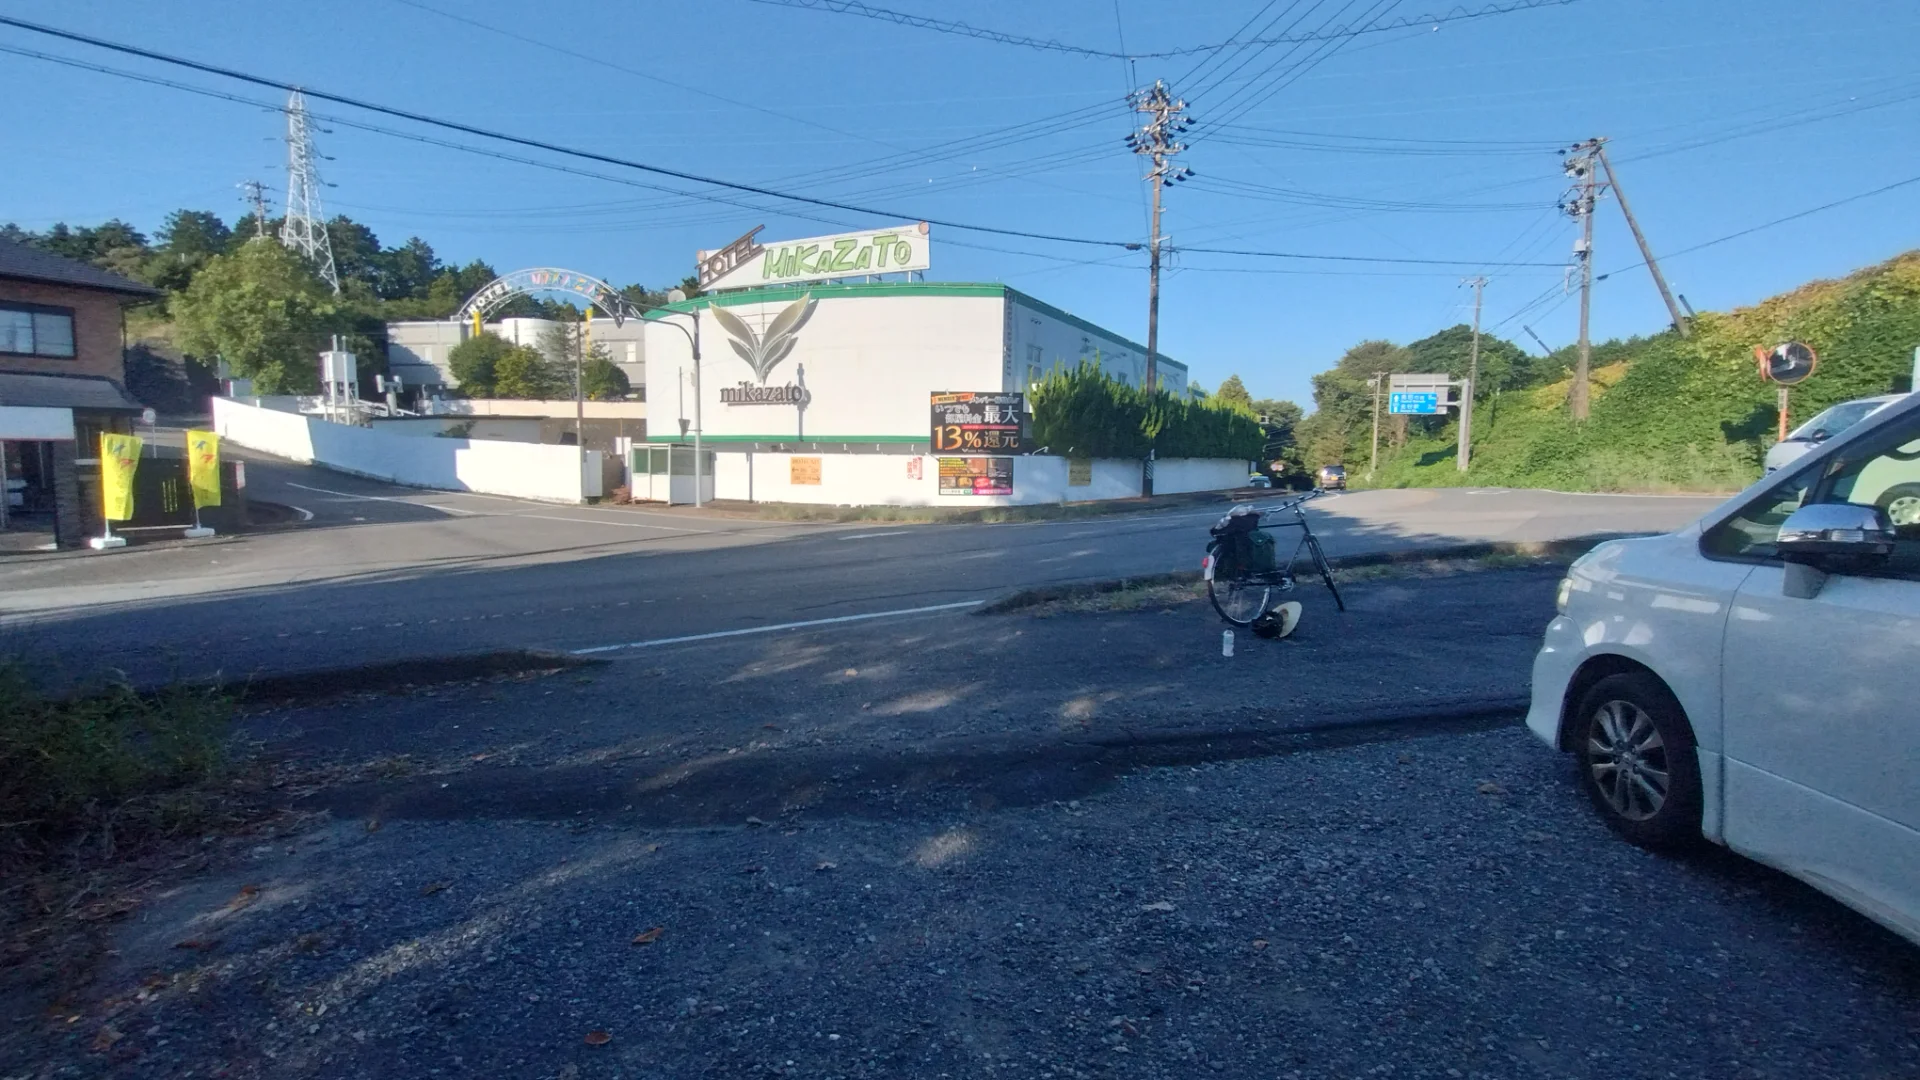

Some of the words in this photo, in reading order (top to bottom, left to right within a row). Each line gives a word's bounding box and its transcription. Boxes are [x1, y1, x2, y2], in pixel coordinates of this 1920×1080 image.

[698, 233, 766, 287] HOTEL
[467, 281, 513, 316] HOTEL
[719, 380, 803, 403] mikazato
[983, 404, 1020, 424] 最大
